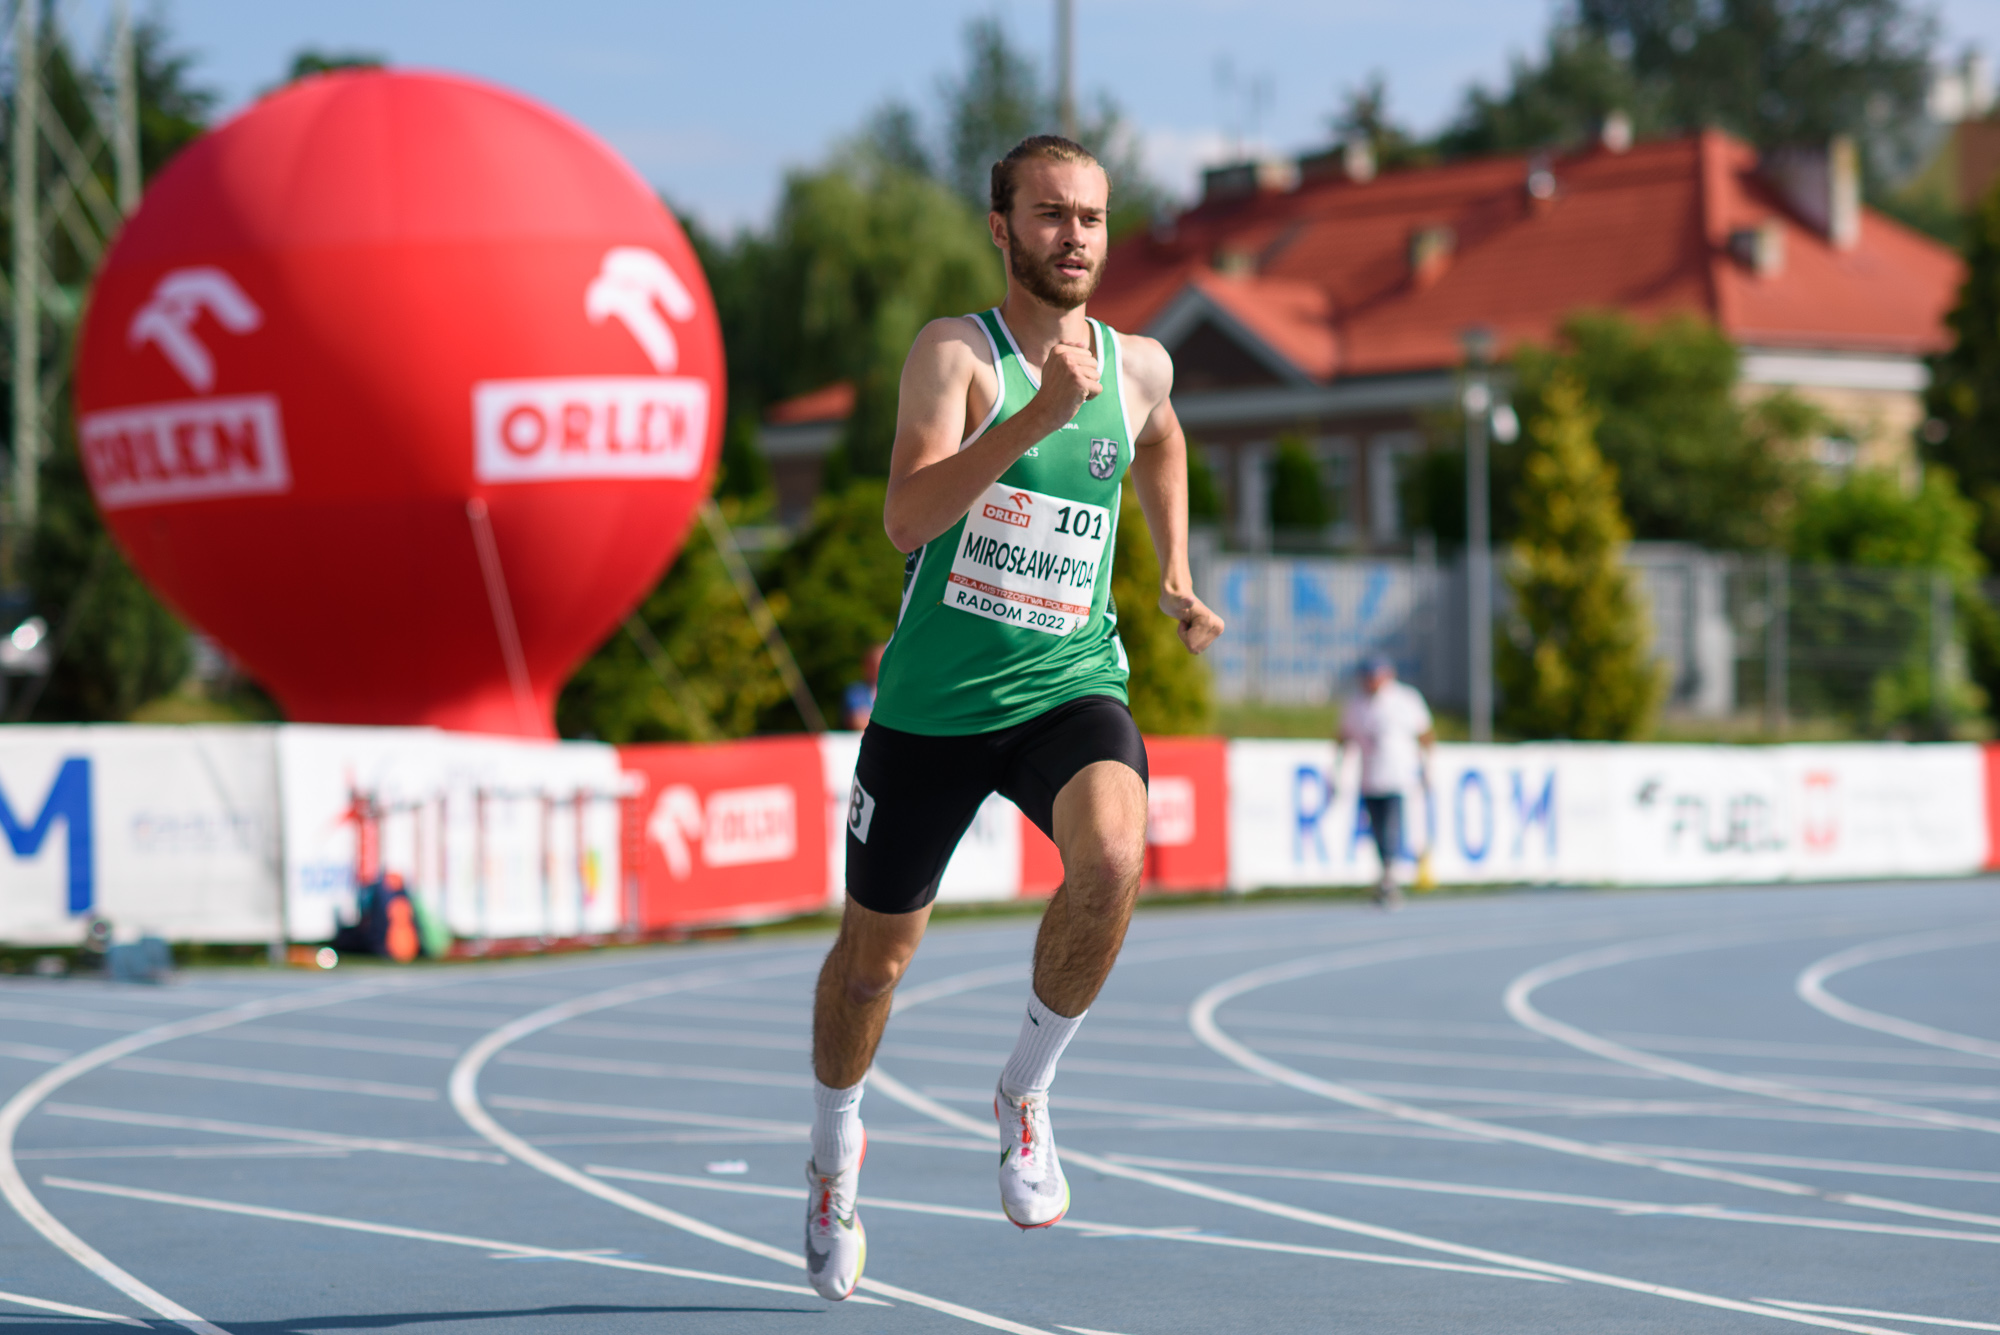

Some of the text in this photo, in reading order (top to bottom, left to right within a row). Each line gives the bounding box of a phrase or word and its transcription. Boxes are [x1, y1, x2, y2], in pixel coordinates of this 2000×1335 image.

[499, 400, 694, 460] ORLEN
[985, 506, 1029, 527] ORLEN
[1054, 506, 1103, 540] 101
[962, 531, 1094, 590] MIROSŁAW-PYDA
[953, 574, 978, 589] PZLA
[979, 583, 1044, 606] MISTRZOSTWA
[1044, 600, 1075, 613] POLSKI
[956, 590, 1065, 630] RADOM 2022
[849, 784, 865, 829] 8
